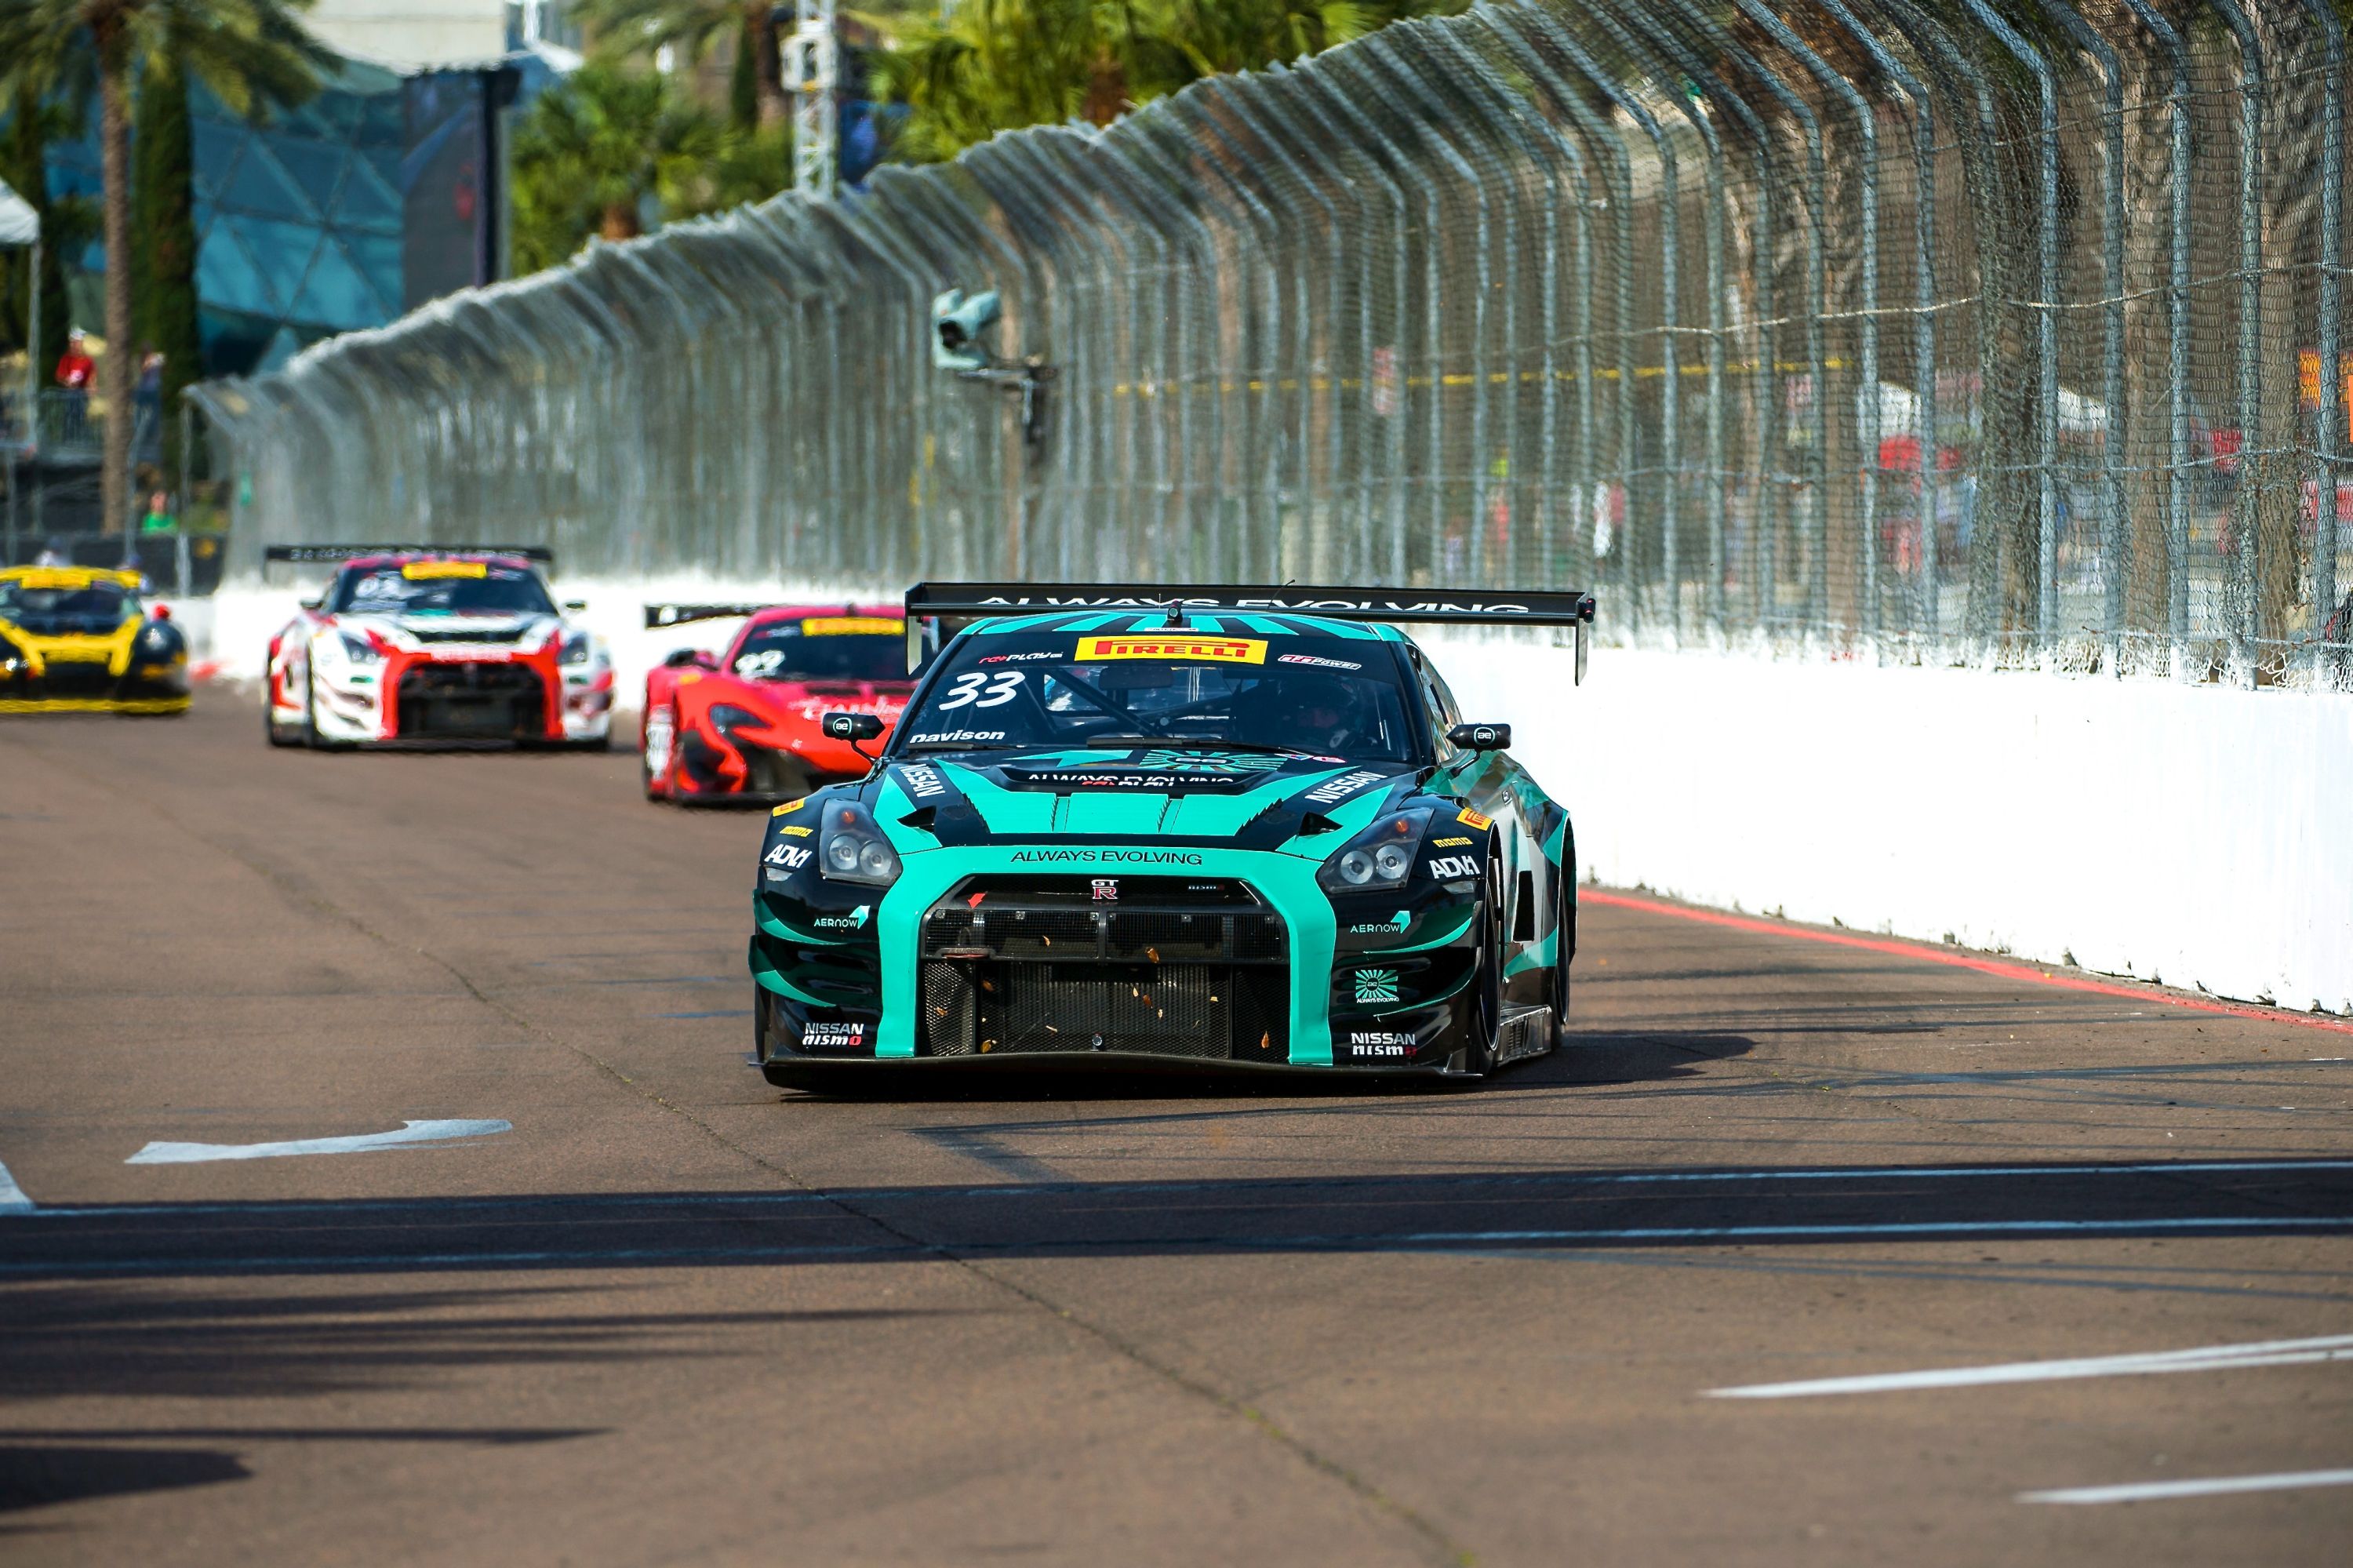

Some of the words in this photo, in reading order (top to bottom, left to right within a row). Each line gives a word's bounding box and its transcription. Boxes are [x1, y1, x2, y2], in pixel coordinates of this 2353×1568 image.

[1094, 640, 1250, 657] PIRELLI
[938, 671, 1026, 711] 33
[897, 763, 946, 798] NISSAN
[1304, 770, 1388, 804] NISSAN
[1010, 850, 1096, 863] ALWAYS
[1100, 850, 1202, 865] EVOLVING
[1091, 879, 1119, 887] GT
[1092, 886, 1118, 900] R
[805, 1022, 864, 1035] NISSAN
[802, 1035, 862, 1046] nismo
[1351, 1032, 1417, 1046] NISSAN
